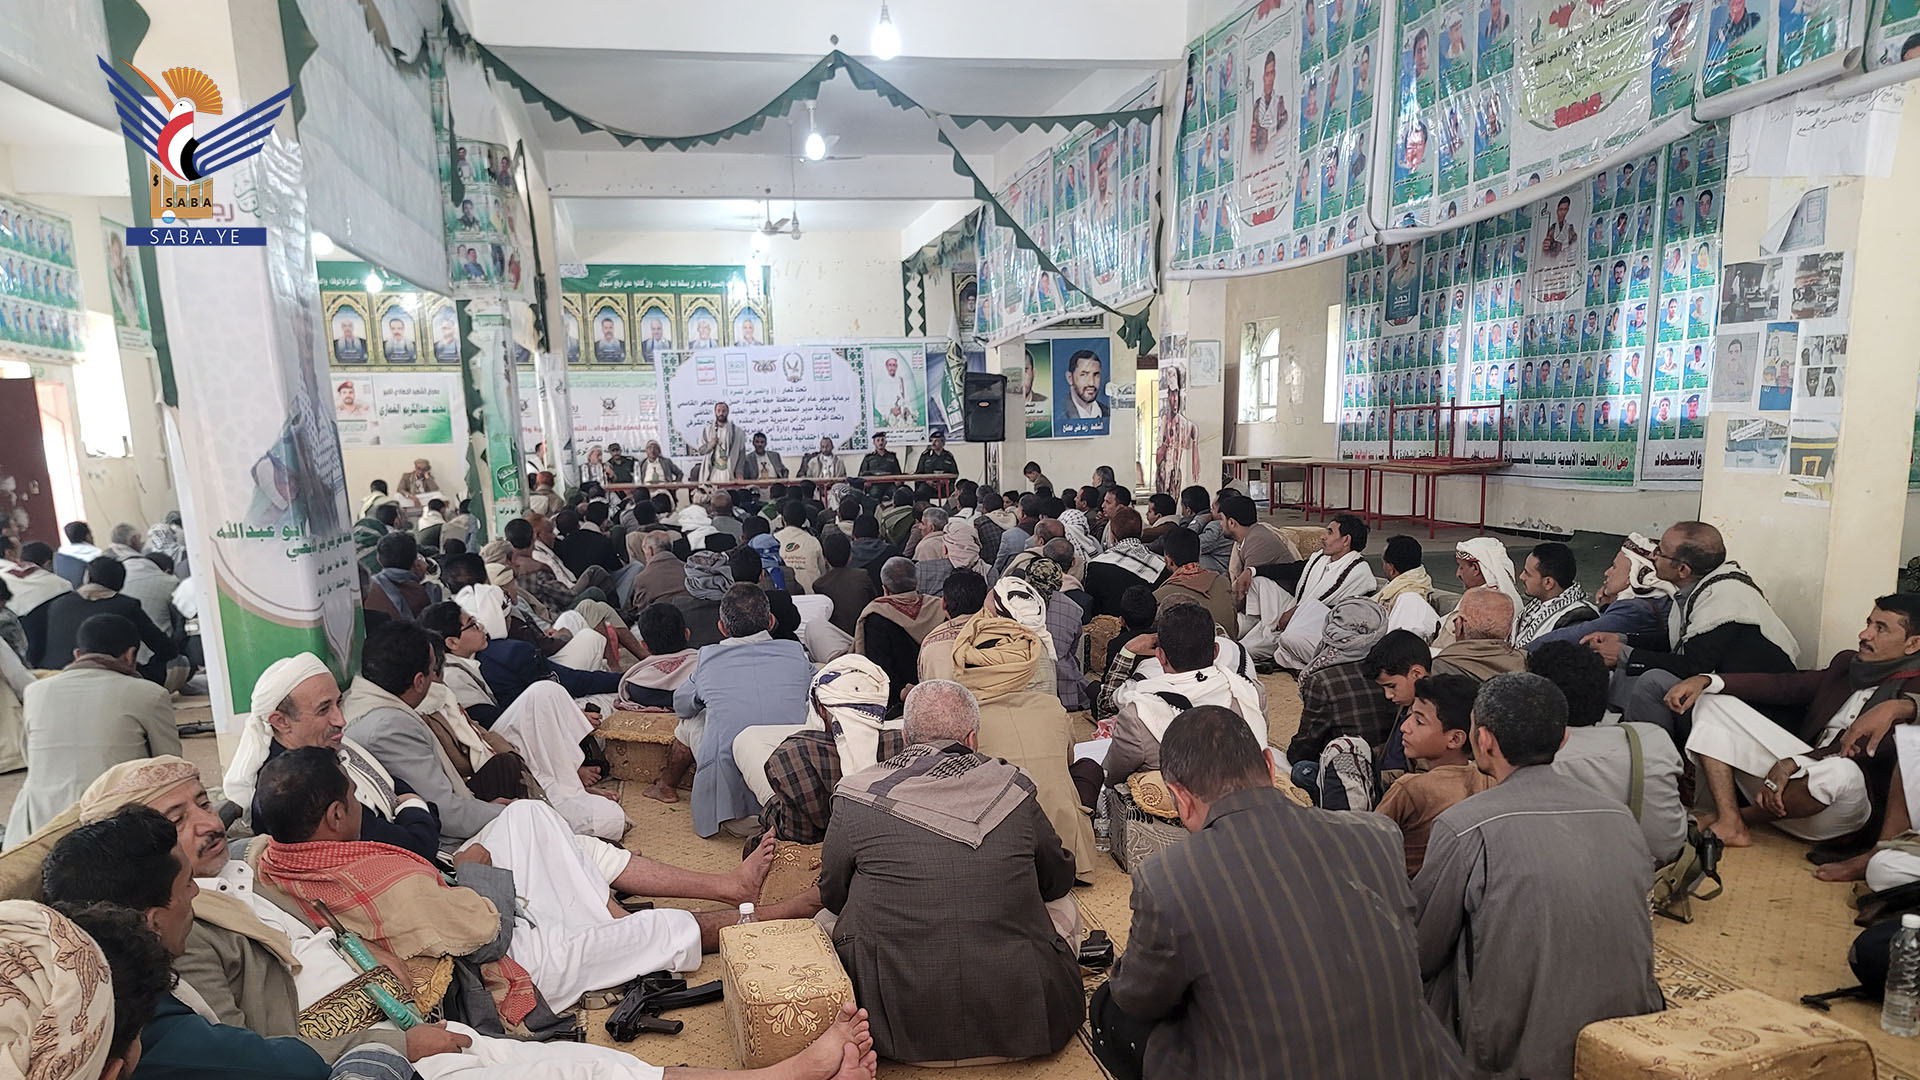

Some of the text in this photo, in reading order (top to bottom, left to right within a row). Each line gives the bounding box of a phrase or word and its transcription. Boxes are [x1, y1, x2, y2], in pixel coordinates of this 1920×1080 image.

[1557, 449, 1579, 469] الأبدية
[1580, 452, 1601, 469] الحياة
[1601, 449, 1616, 470] أراد
[1616, 454, 1629, 471] من
